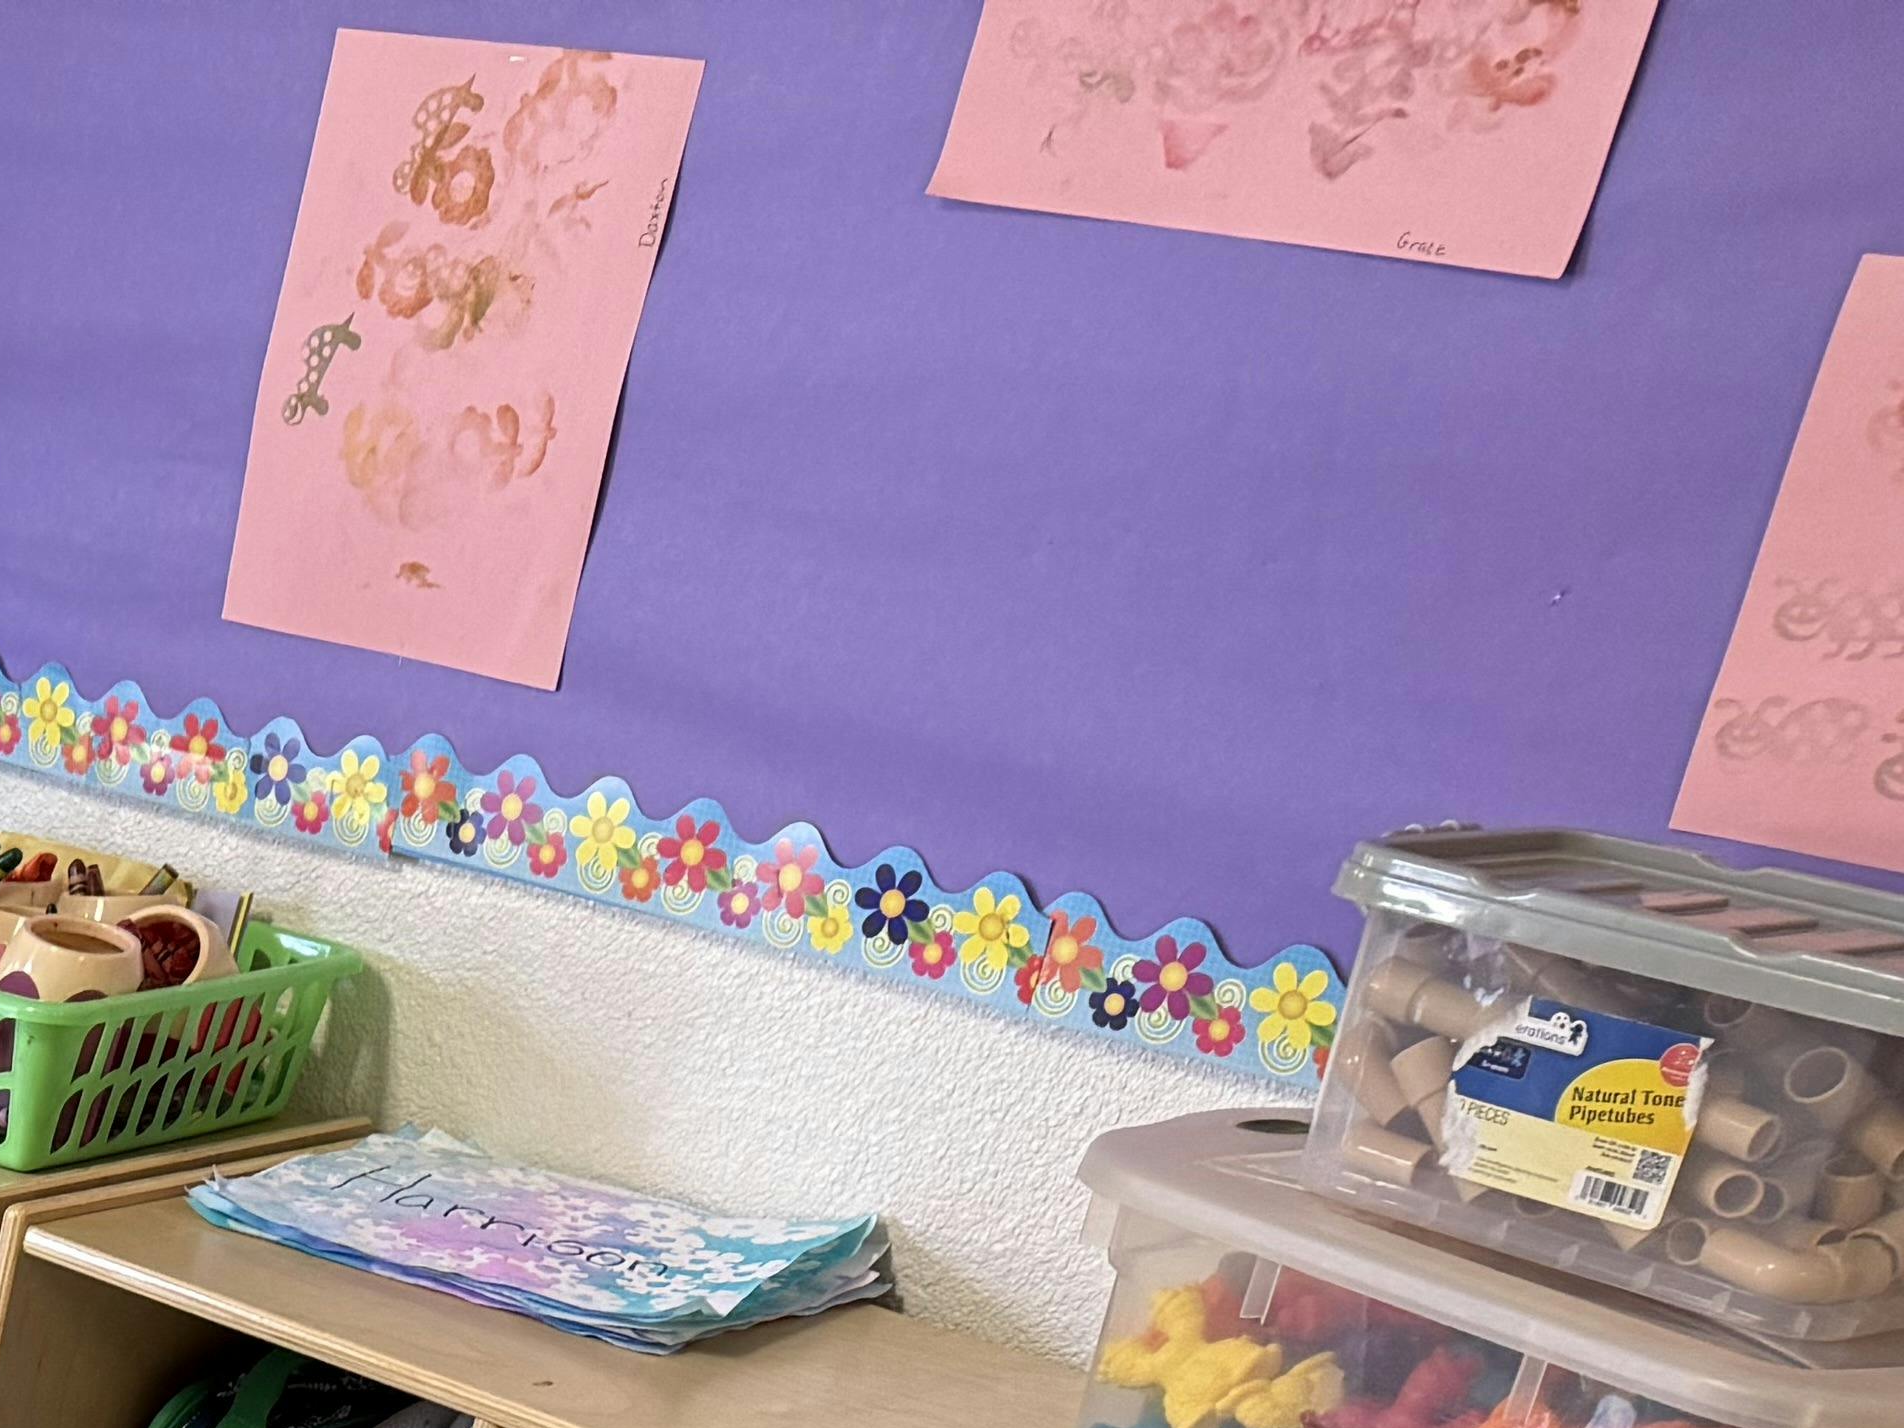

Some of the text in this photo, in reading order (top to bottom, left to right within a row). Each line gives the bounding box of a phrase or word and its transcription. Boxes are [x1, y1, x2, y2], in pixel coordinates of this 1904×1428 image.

[638, 178, 668, 247] Daxton
[1515, 1023, 1567, 1047] erations
[1571, 1086, 1637, 1106] Natural
[1467, 1101, 1512, 1127] PIECES
[1569, 1106, 1656, 1127] Pipetubes
[330, 1165, 669, 1277] Harrison
